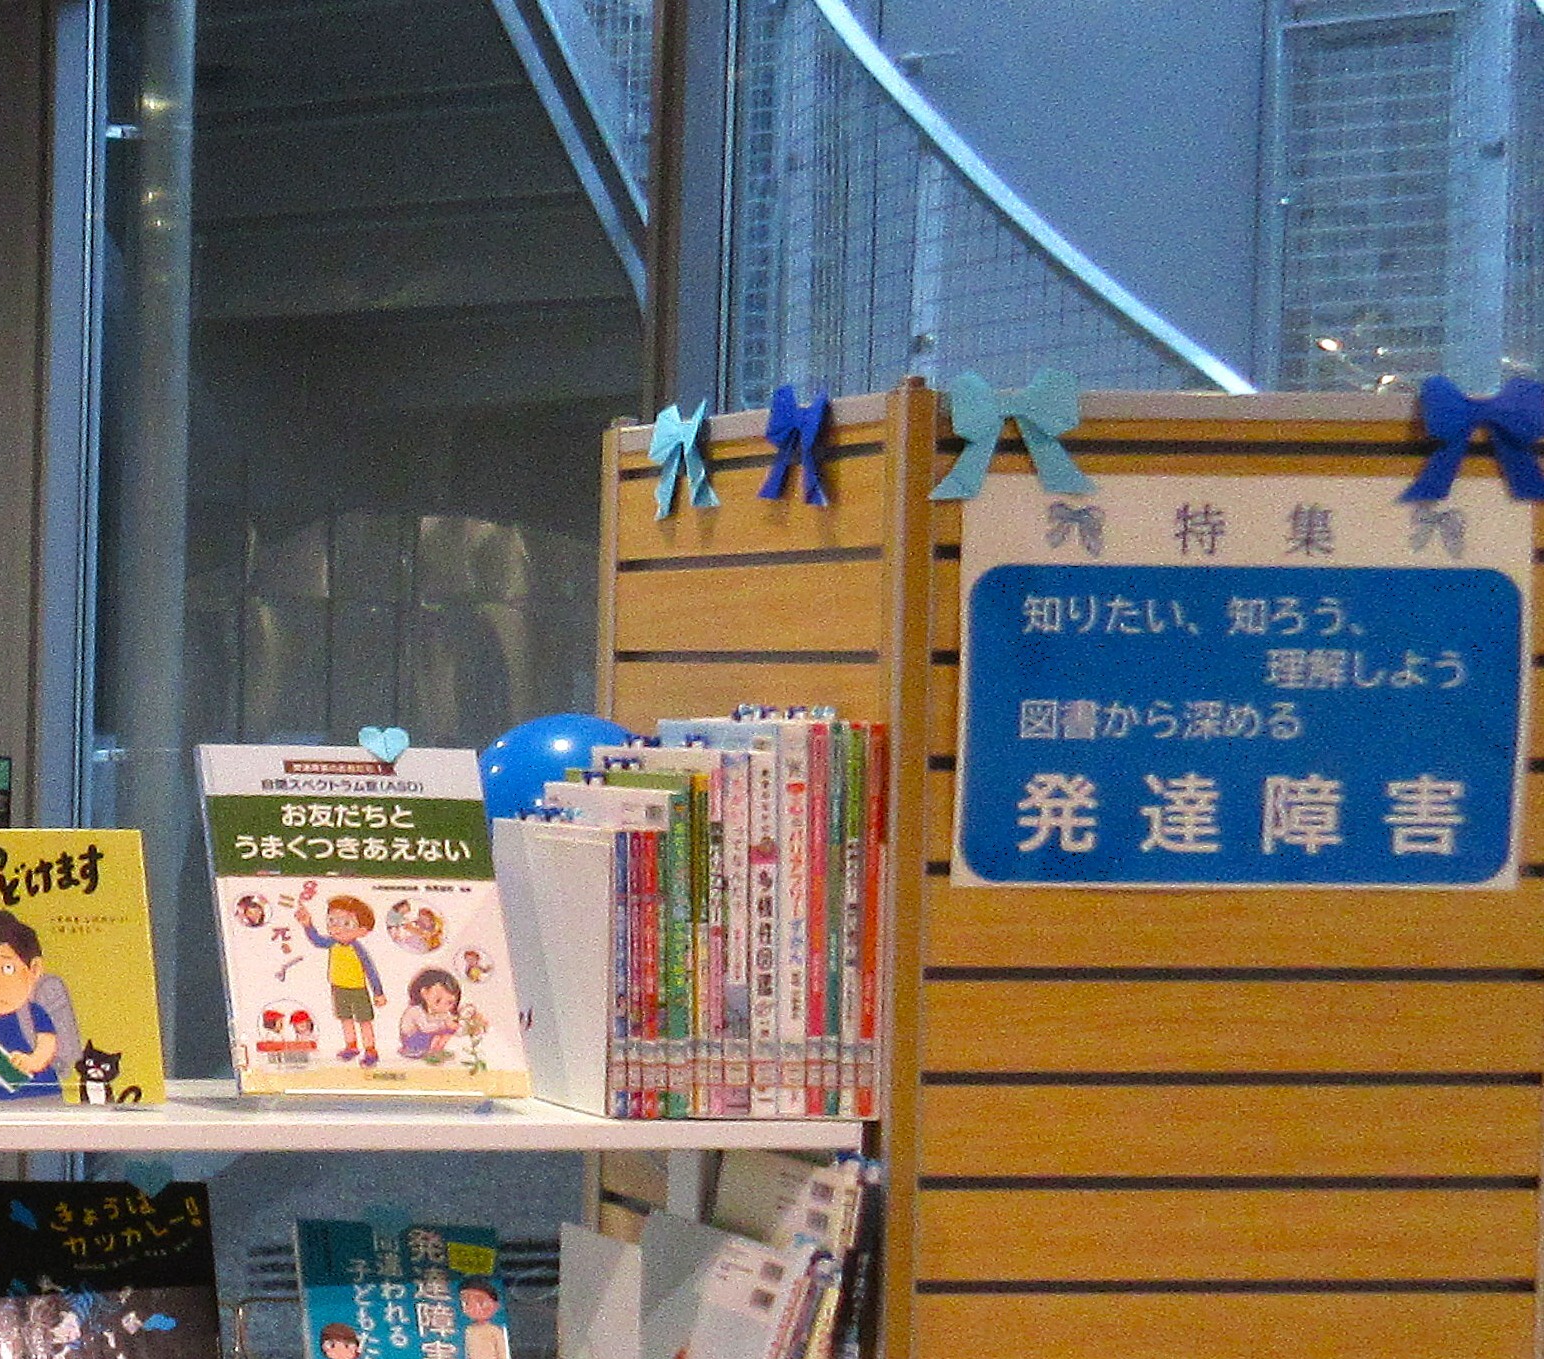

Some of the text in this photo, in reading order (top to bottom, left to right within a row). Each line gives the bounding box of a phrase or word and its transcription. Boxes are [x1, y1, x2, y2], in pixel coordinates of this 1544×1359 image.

[1174, 503, 1336, 557] 特集
[1022, 597, 1364, 636] 知りたい、 知ろう、
[1267, 649, 1468, 689] 理解しよう
[1020, 700, 1305, 740] 図書から深める
[280, 804, 414, 829] お友だちと
[1017, 772, 1468, 855] 発達障害
[235, 835, 471, 862] うまくつきあえない
